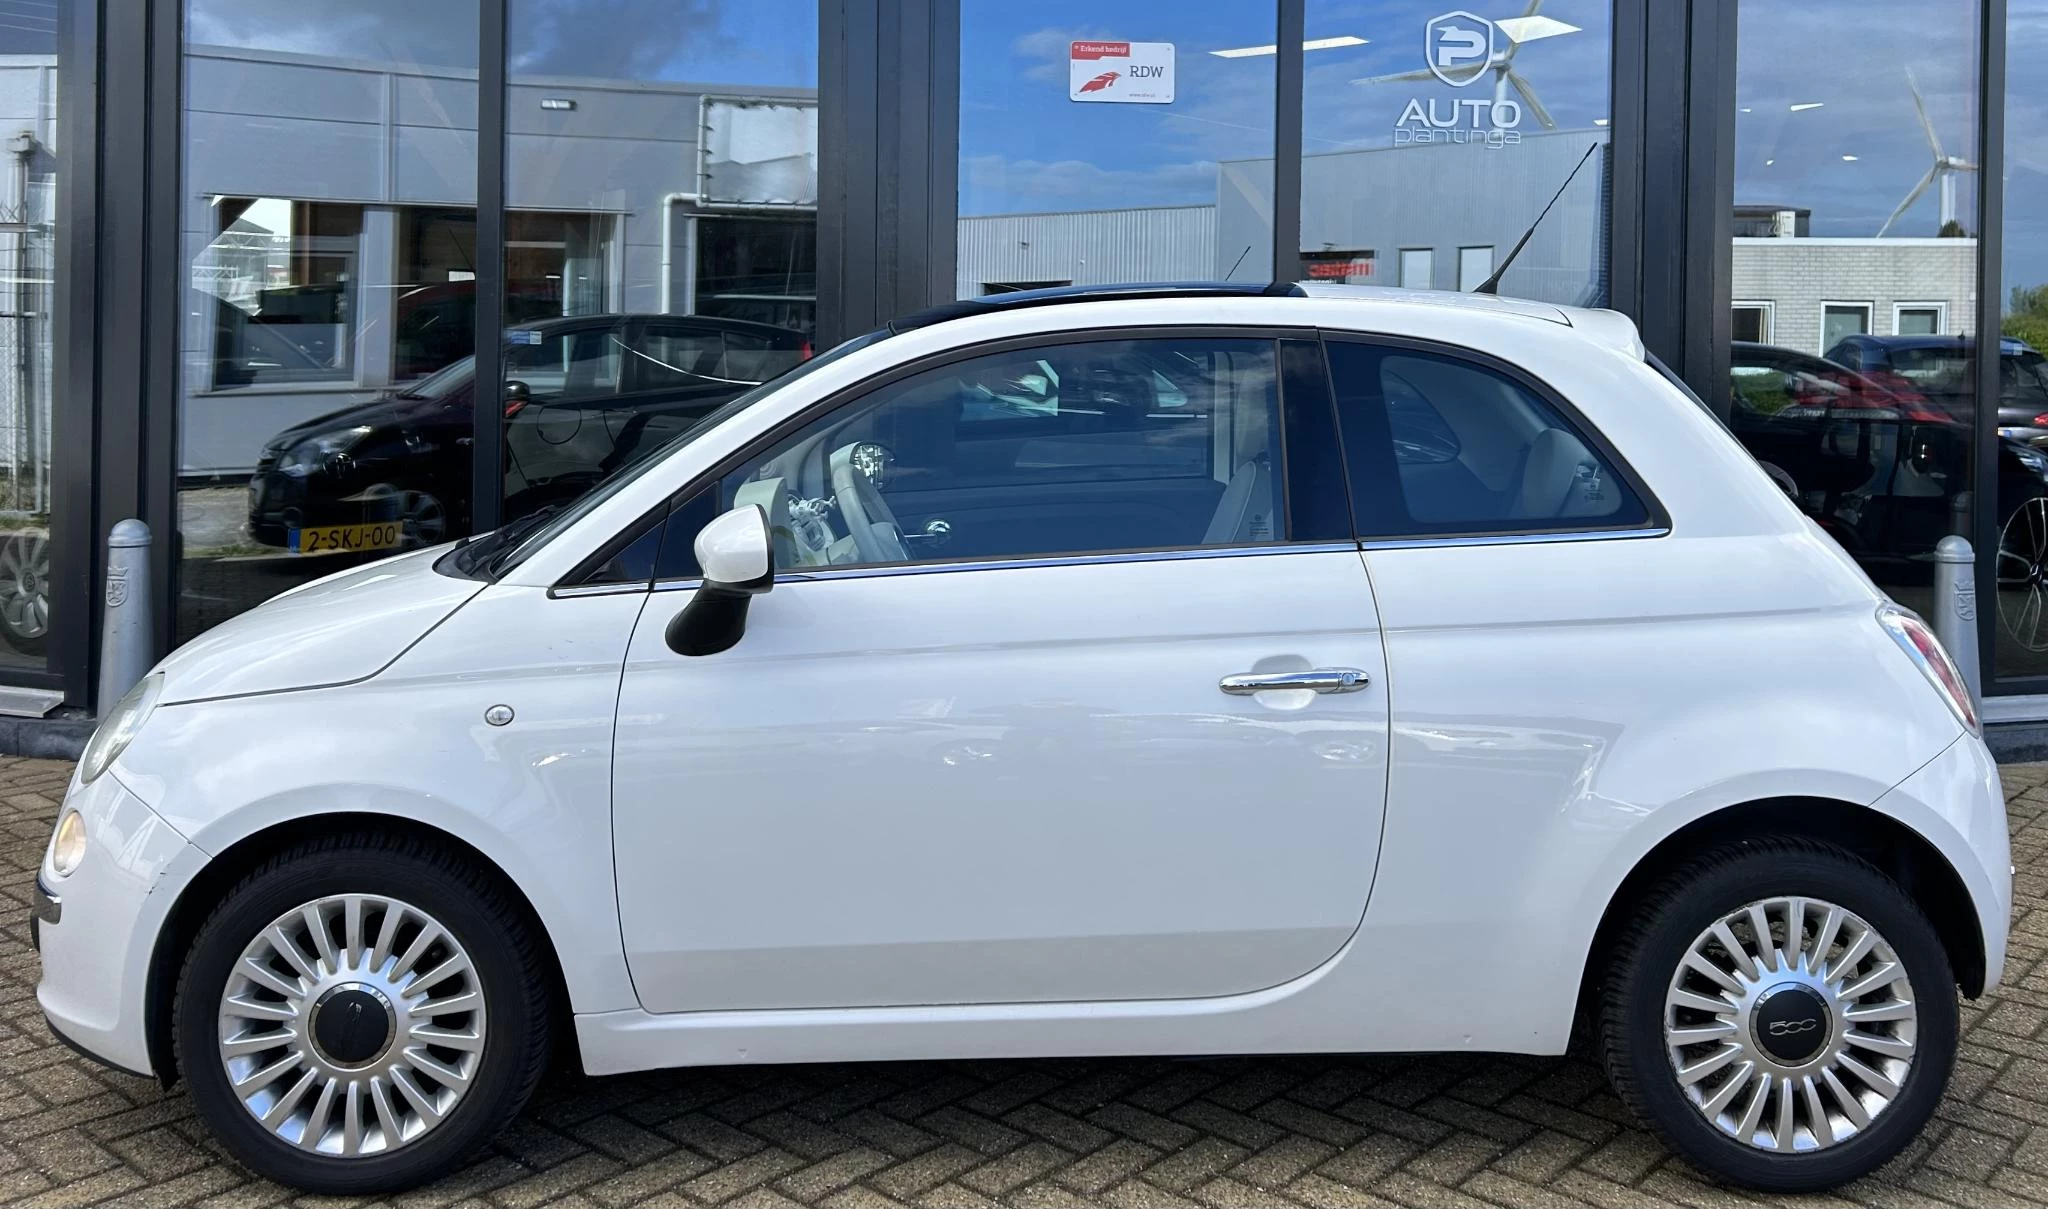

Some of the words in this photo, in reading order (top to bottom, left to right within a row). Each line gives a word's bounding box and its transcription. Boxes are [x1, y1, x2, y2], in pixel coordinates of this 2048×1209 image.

[1080, 45, 1105, 53] Erkend
[1129, 65, 1165, 79] RDW
[1396, 98, 1521, 128] AUTO
[1394, 126, 1521, 149] plantinga
[306, 525, 396, 552] 2-SKJ-00
[1769, 1018, 1817, 1036] 500
